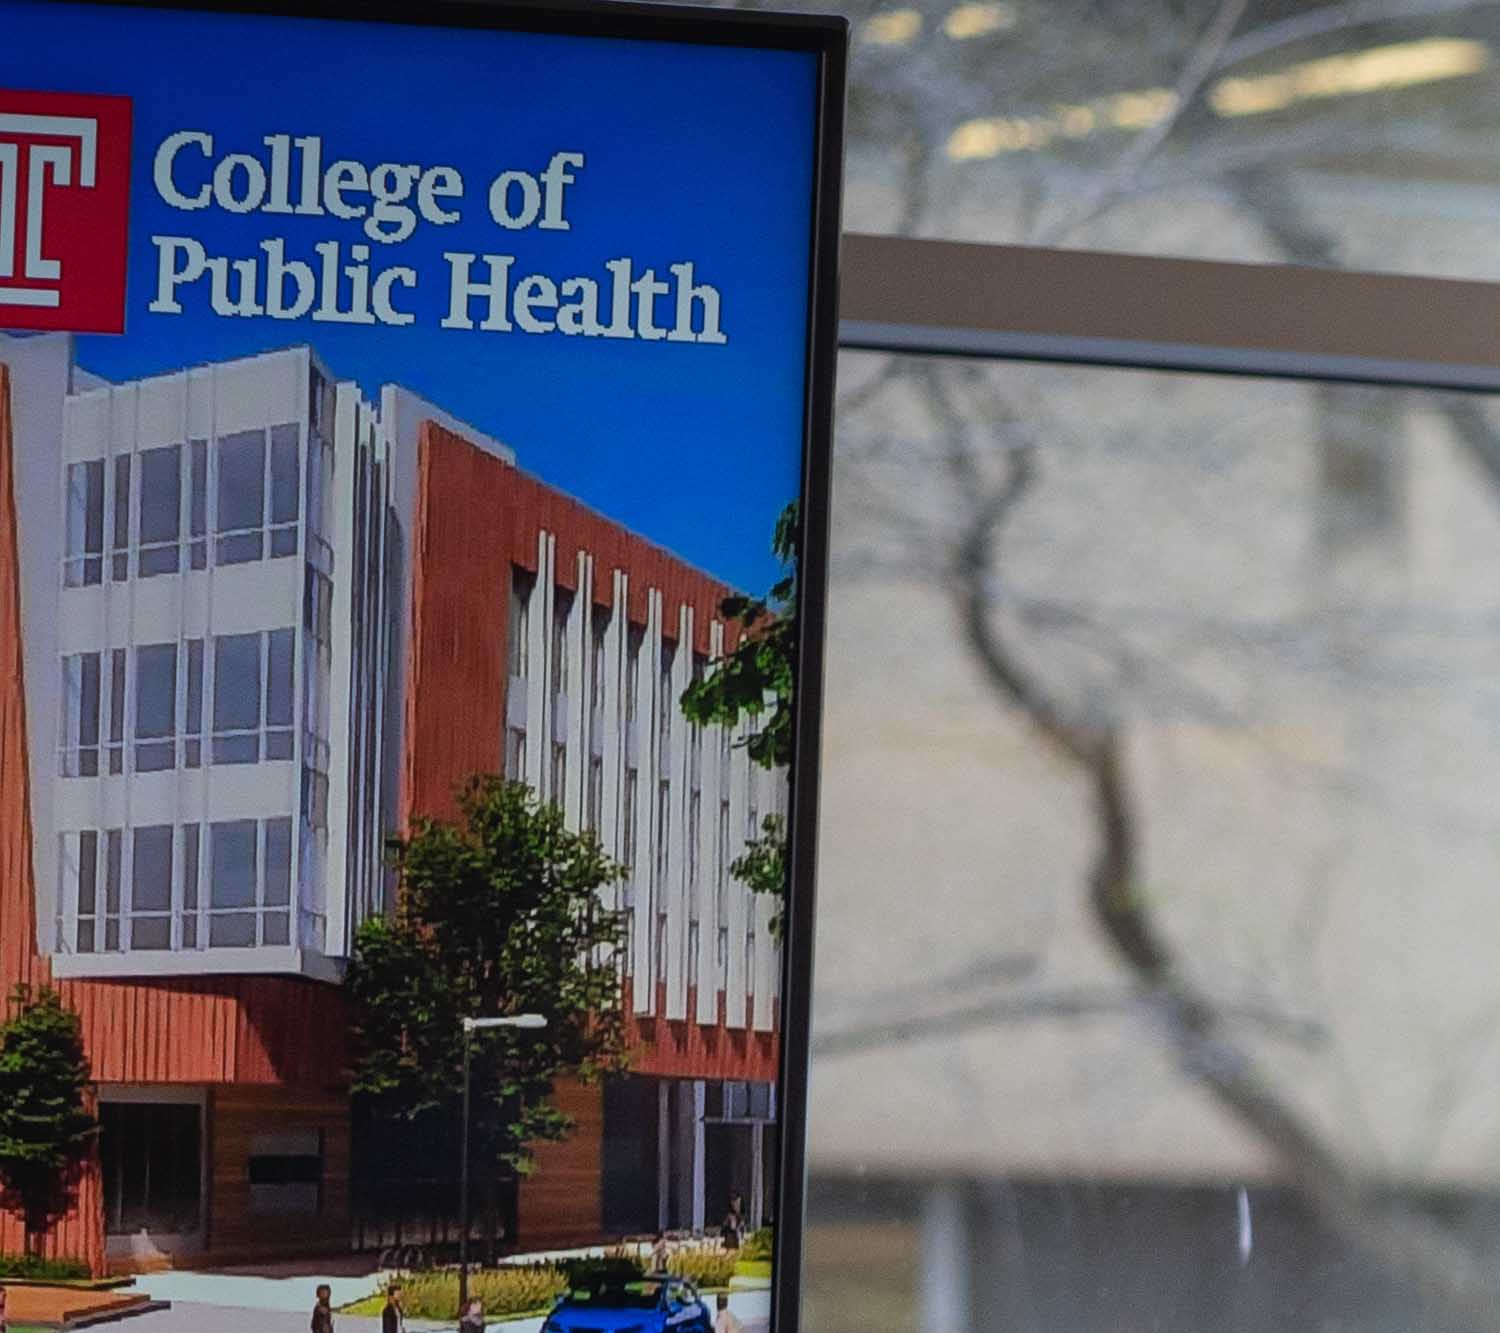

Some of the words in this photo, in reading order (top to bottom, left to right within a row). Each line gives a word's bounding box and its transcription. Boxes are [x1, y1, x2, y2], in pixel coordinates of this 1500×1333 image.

[152, 131, 464, 243] College
[489, 152, 584, 231] of
[149, 235, 416, 326] Public
[441, 252, 727, 345] Health
